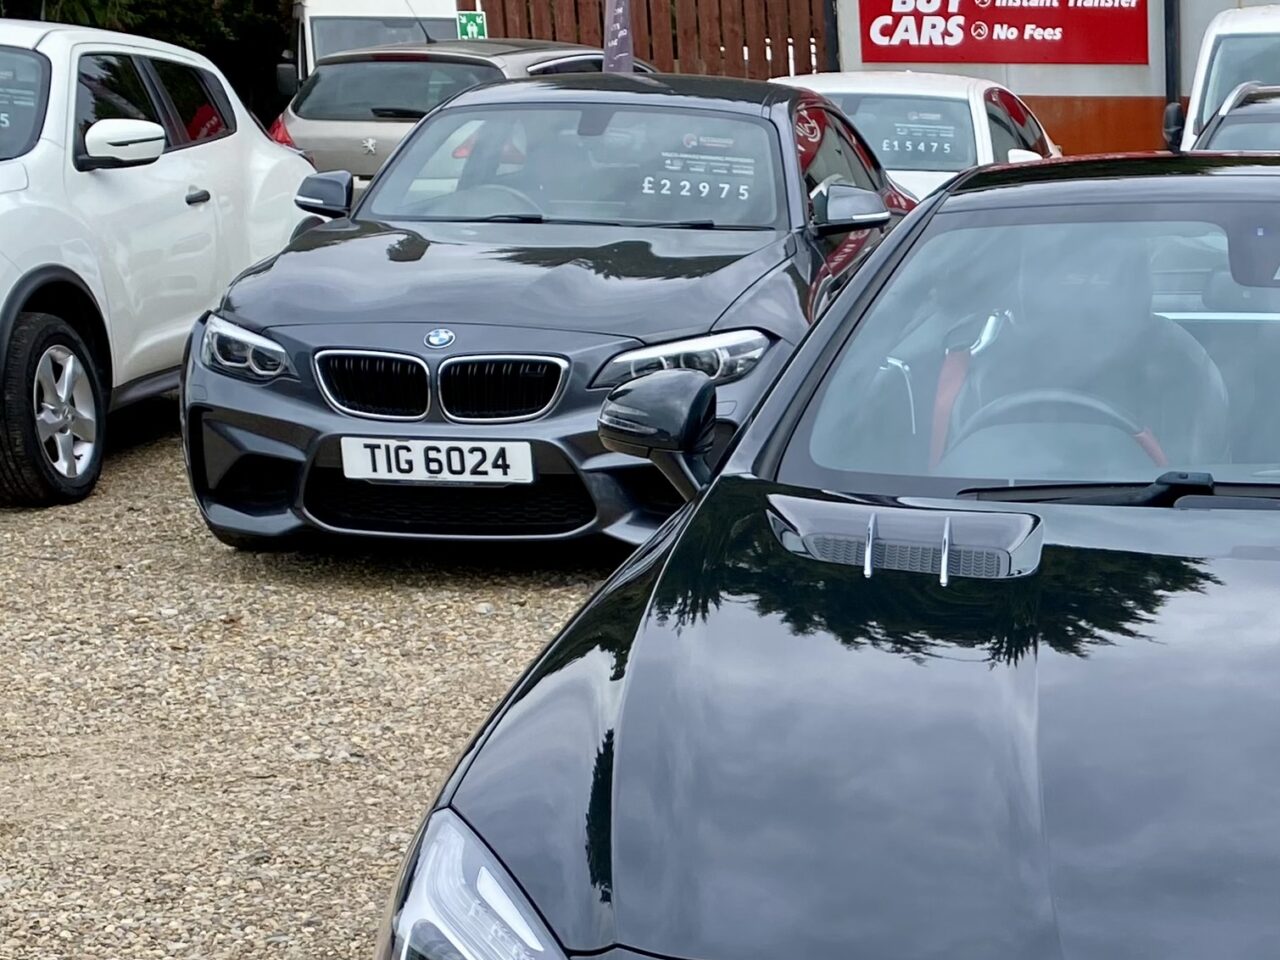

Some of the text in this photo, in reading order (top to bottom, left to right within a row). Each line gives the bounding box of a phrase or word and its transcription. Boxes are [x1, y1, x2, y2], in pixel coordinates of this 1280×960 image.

[869, 15, 965, 46] CARS
[992, 24, 1063, 40] No Fees
[882, 139, 951, 153] £15475
[642, 176, 749, 200] £22975
[363, 443, 511, 476] TIG 6024
